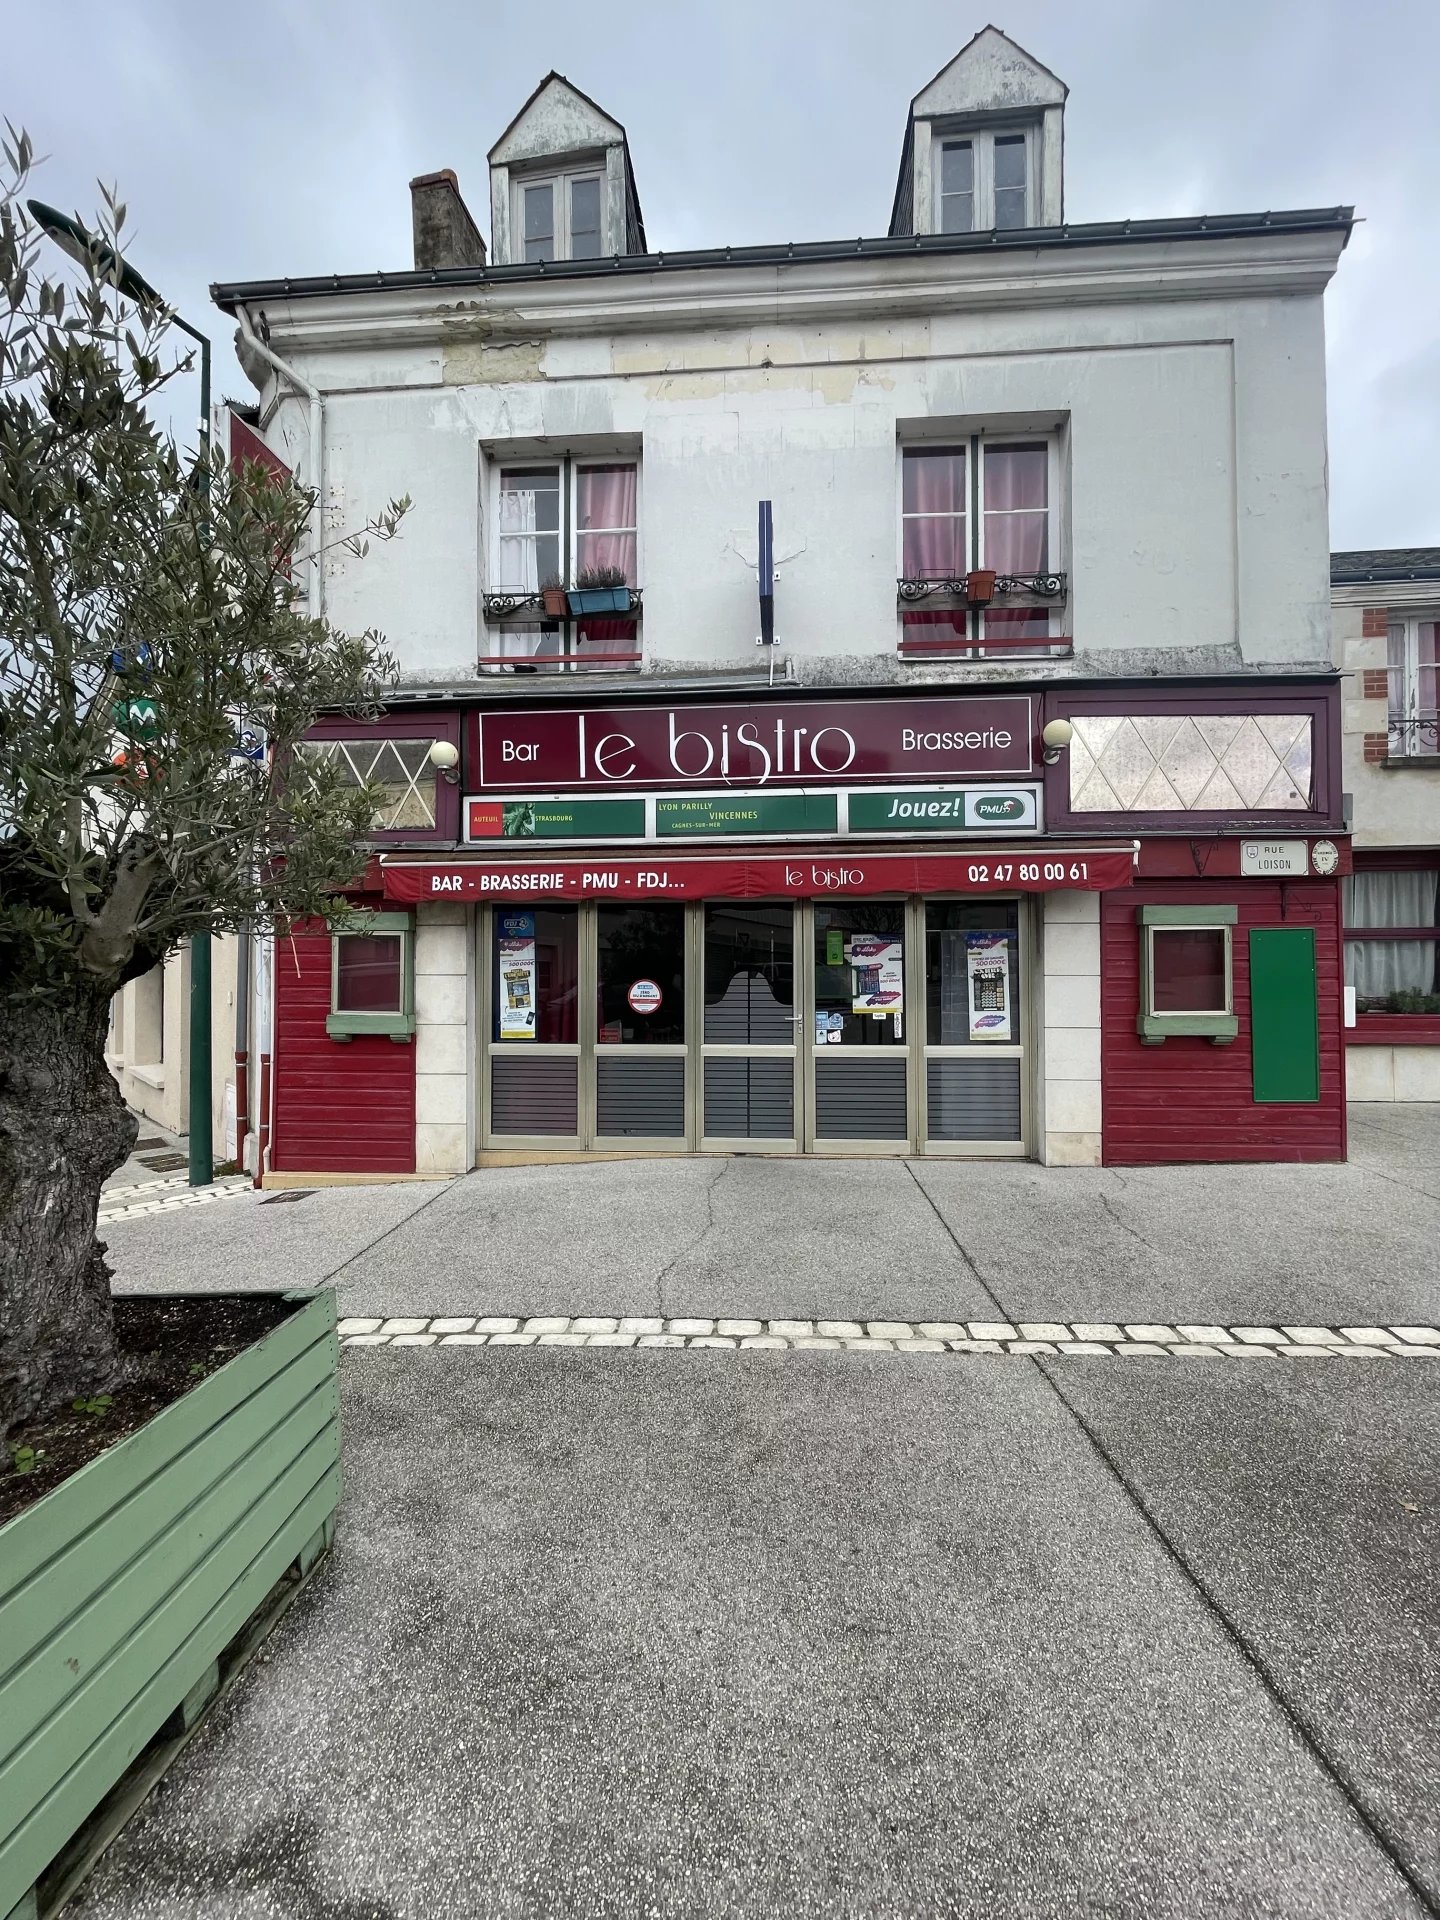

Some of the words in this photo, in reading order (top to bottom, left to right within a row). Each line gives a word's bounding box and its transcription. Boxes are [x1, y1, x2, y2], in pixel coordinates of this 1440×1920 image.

[902, 727, 1012, 751] Brasserie
[502, 741, 540, 762] Bar
[578, 715, 637, 779] le
[668, 712, 857, 785] bistro
[658, 803, 678, 811] LYON
[681, 802, 713, 811] PARILLY
[888, 797, 961, 819] Jouez!
[979, 804, 1004, 814] PMU
[473, 815, 499, 823] AUTEUIL
[535, 814, 573, 823] STRASBOURG
[709, 811, 758, 820] VINCENNES
[671, 821, 721, 829] CAGNES-SUR-MER
[1258, 860, 1291, 869] LOISON
[785, 865, 803, 886] le
[811, 865, 864, 890] bistro
[968, 865, 989, 882] 02
[994, 865, 1013, 882] 47
[1018, 863, 1040, 881] 80
[1044, 863, 1065, 881] 00
[1069, 863, 1088, 880] 61
[431, 875, 462, 891] BAR
[480, 873, 564, 891] BRASSERIE
[582, 872, 619, 889] PMU
[637, 872, 685, 888] FDJ...
